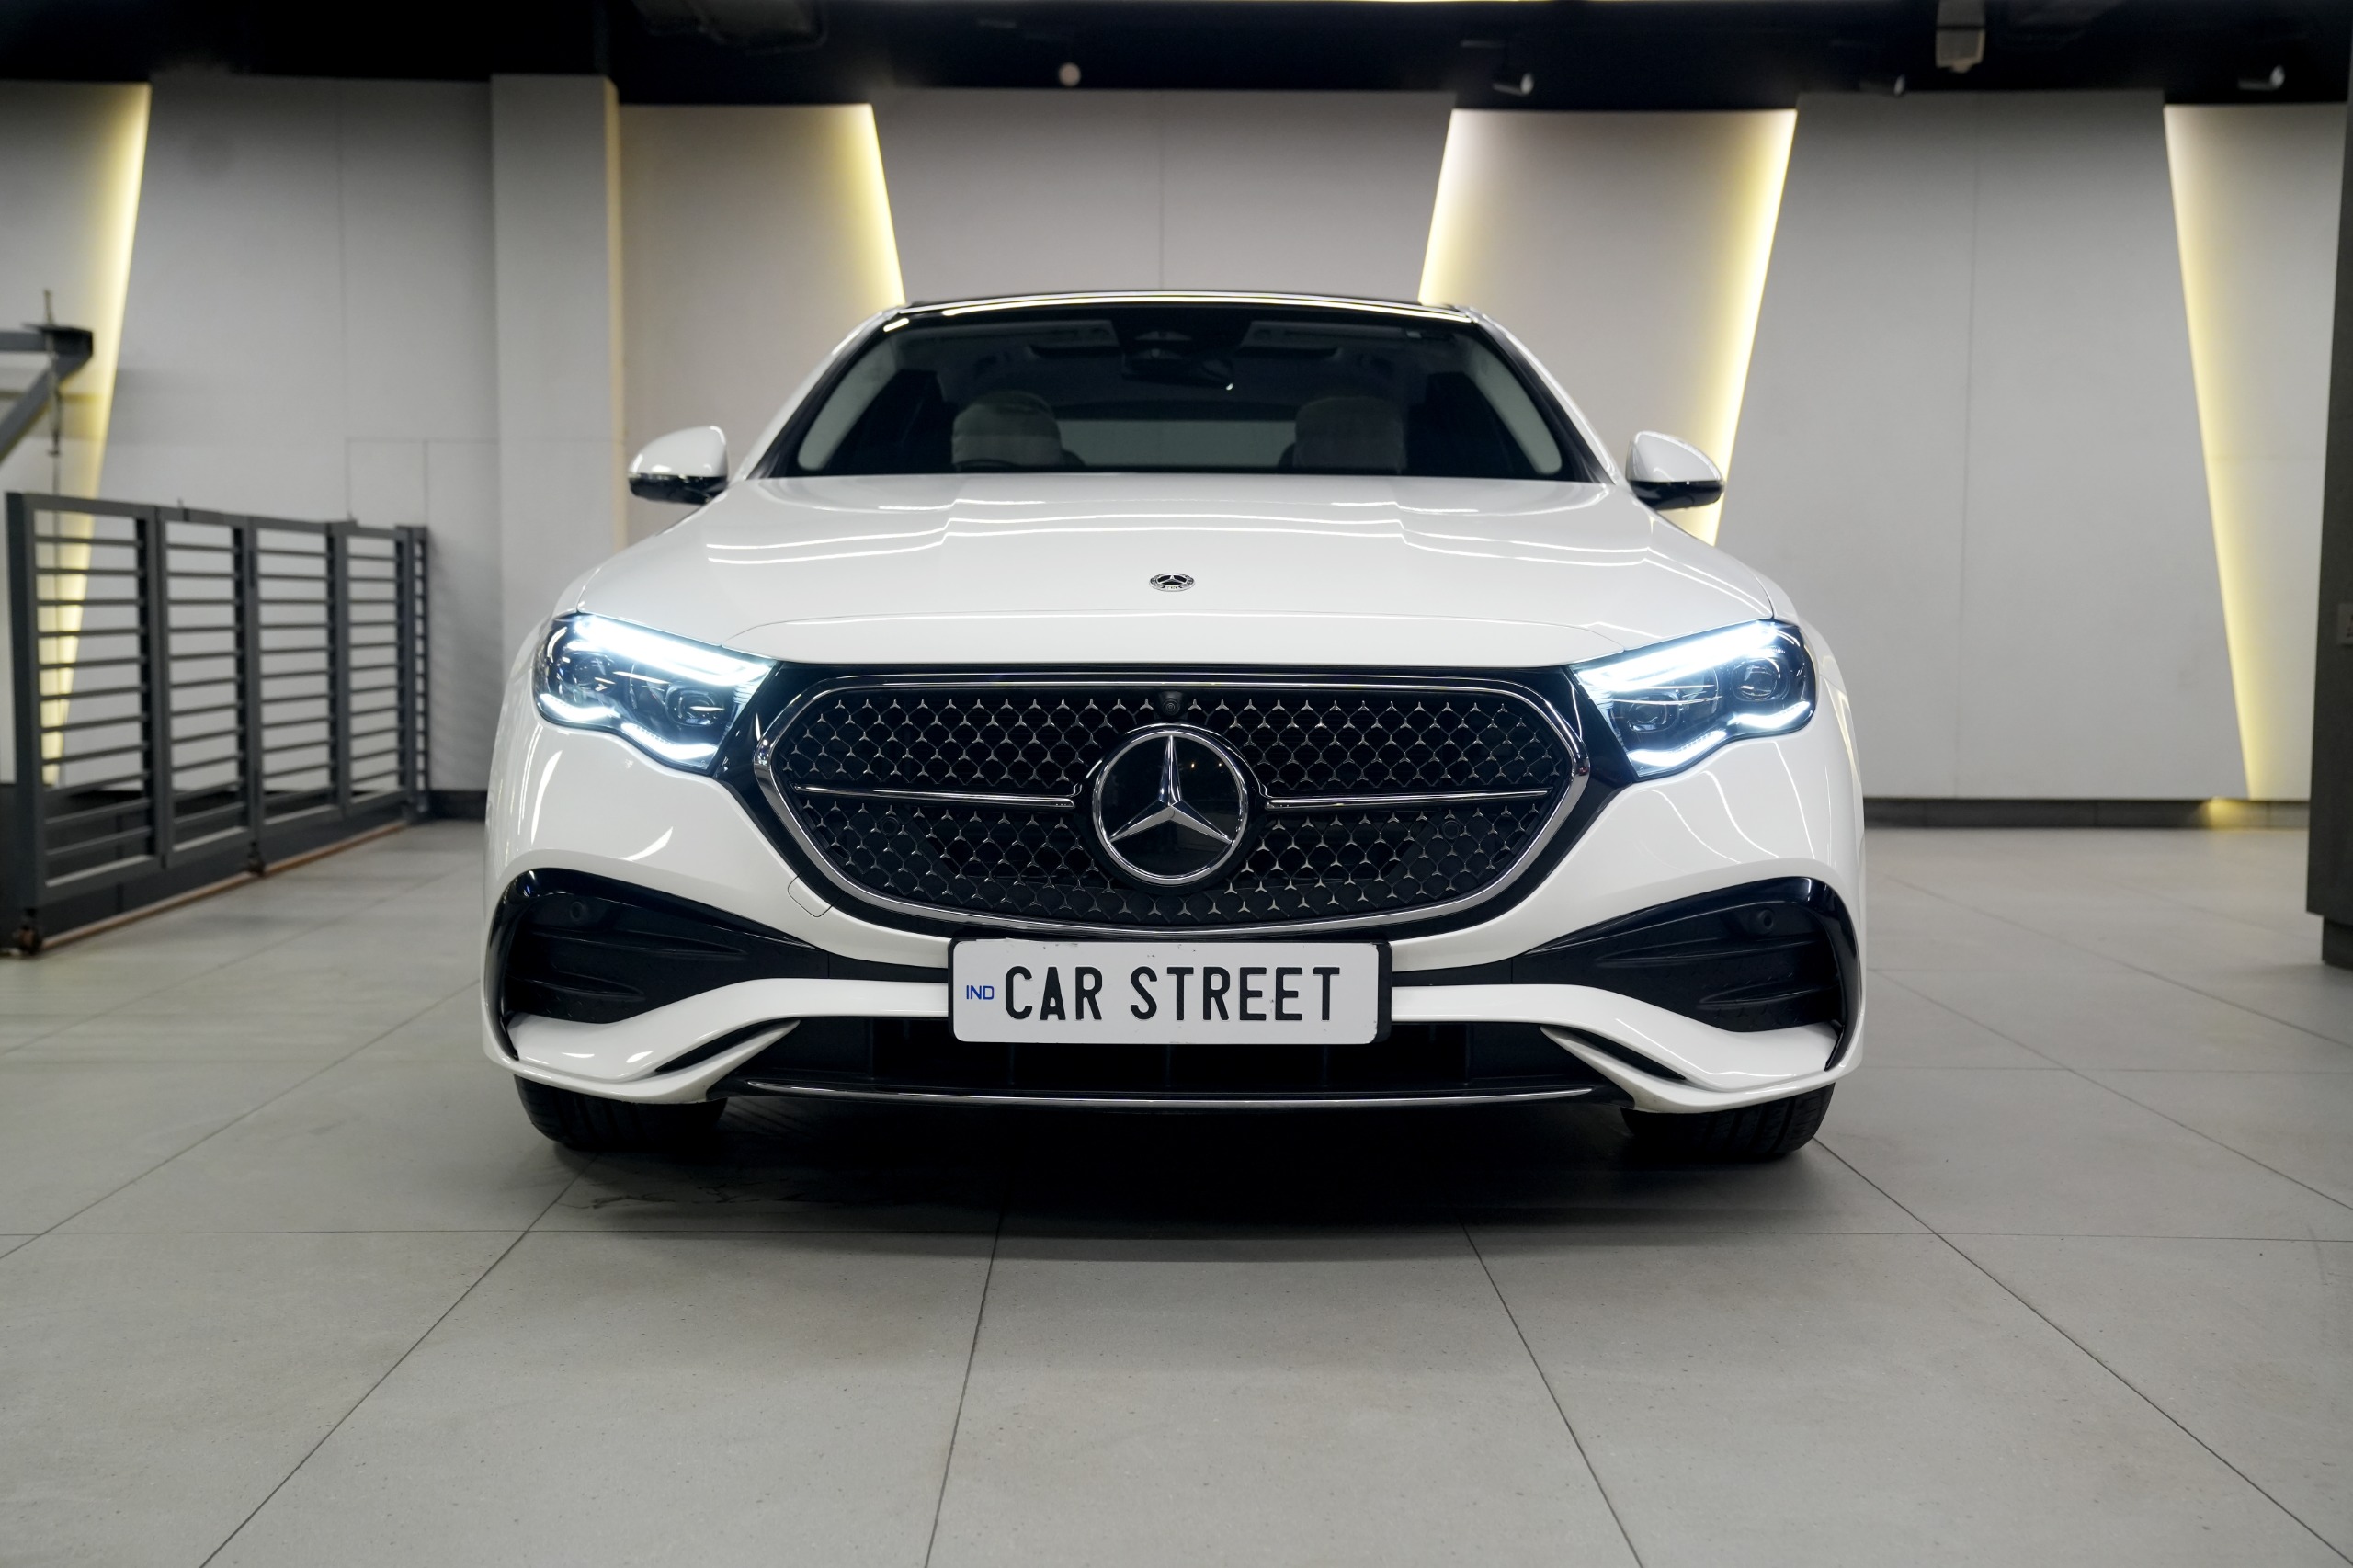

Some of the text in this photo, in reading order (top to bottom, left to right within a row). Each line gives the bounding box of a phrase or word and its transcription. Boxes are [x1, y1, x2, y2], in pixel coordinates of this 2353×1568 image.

[966, 985, 995, 1001] IND
[1006, 966, 1340, 1021] CAR STREET
